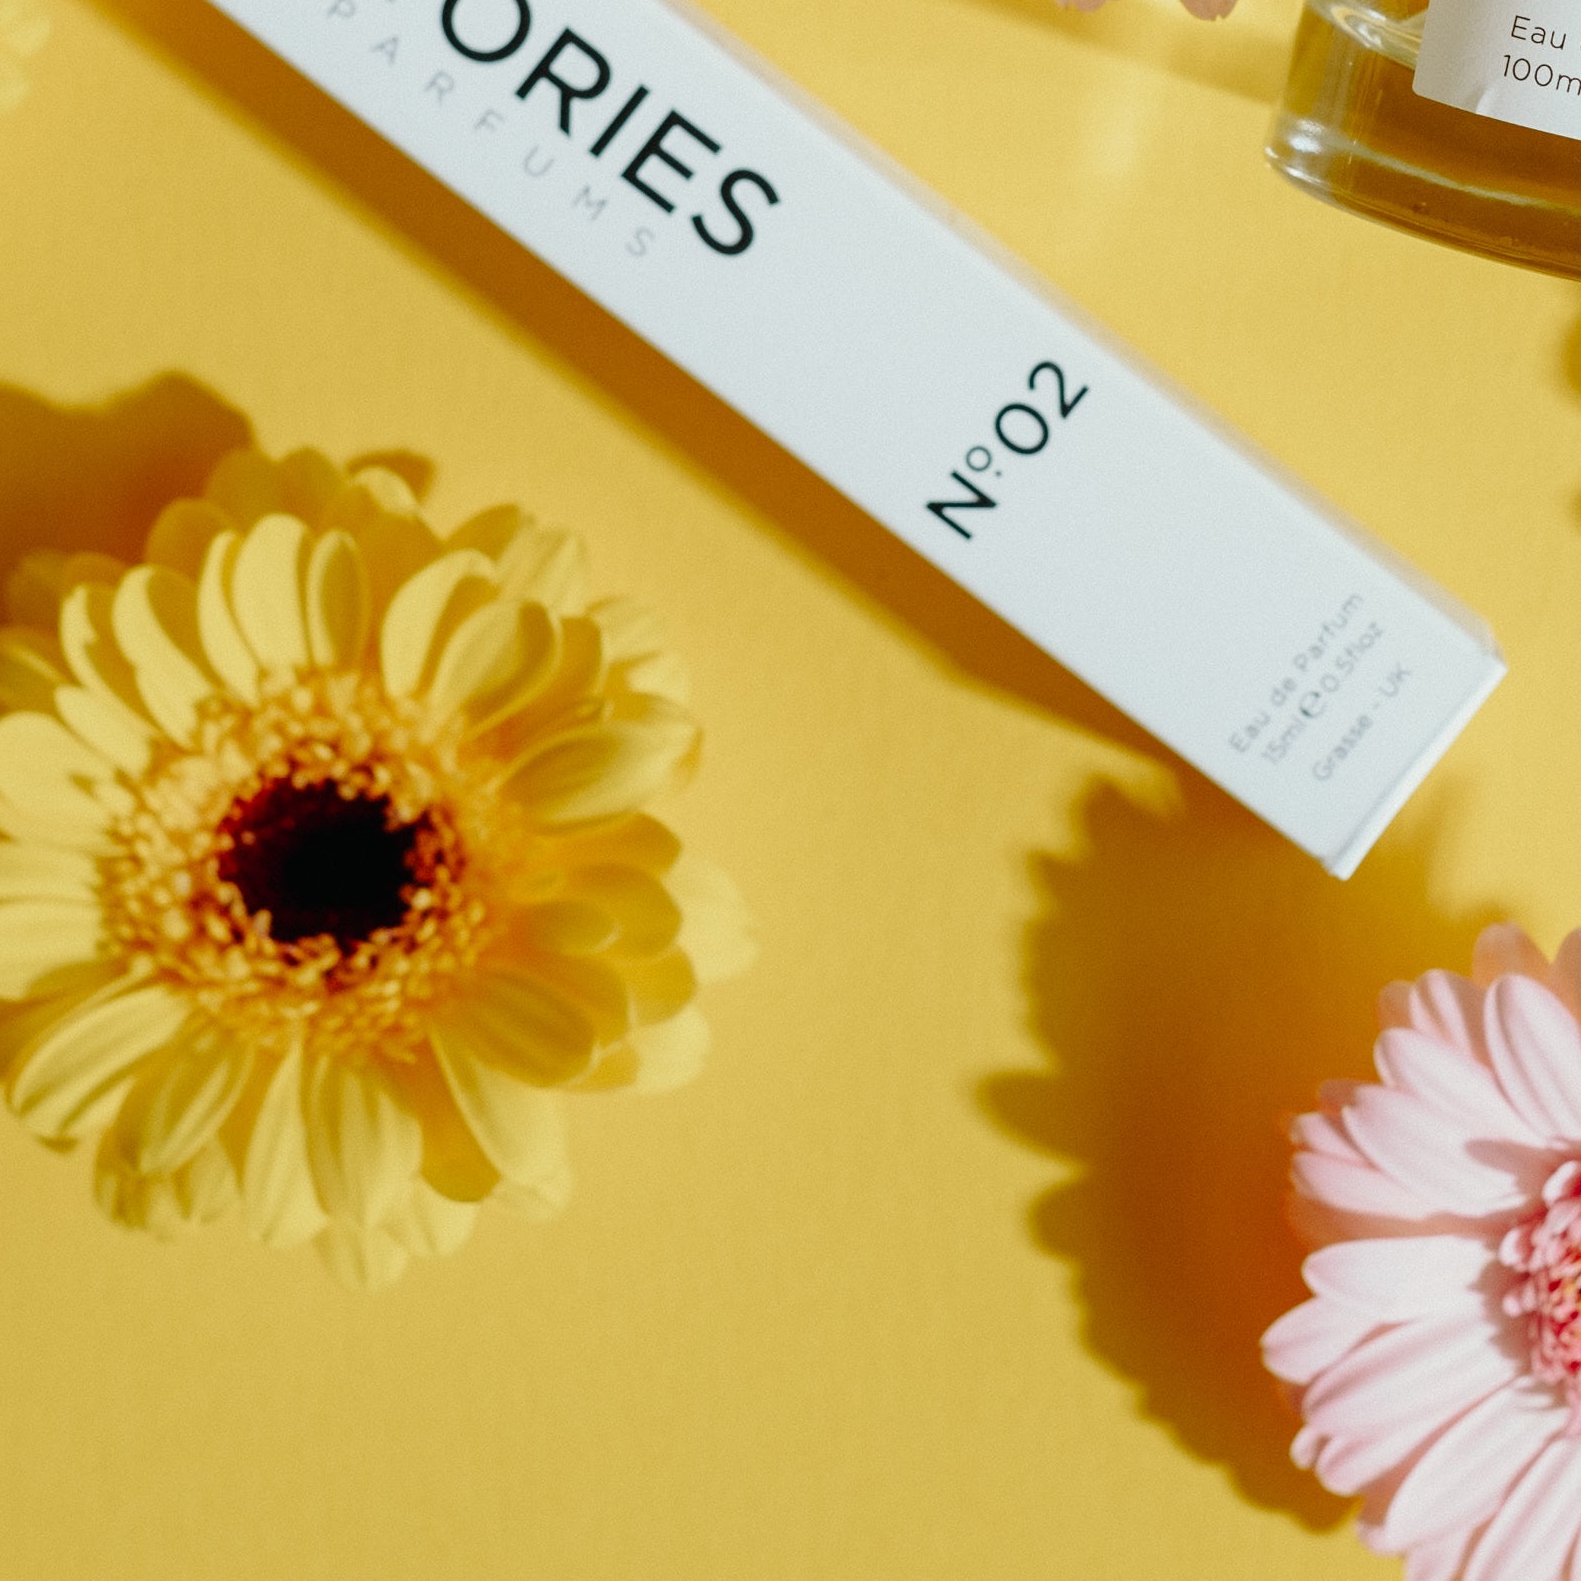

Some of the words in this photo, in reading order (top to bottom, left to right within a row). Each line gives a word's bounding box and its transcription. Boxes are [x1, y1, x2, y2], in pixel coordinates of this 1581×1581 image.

[1510, 14, 1567, 51] Eau
[1228, 709, 1271, 754] Eau
[1270, 677, 1297, 708] de
[1292, 593, 1364, 671] Parfum
[1312, 714, 1372, 781] Grasse
[1378, 663, 1412, 699] UK
